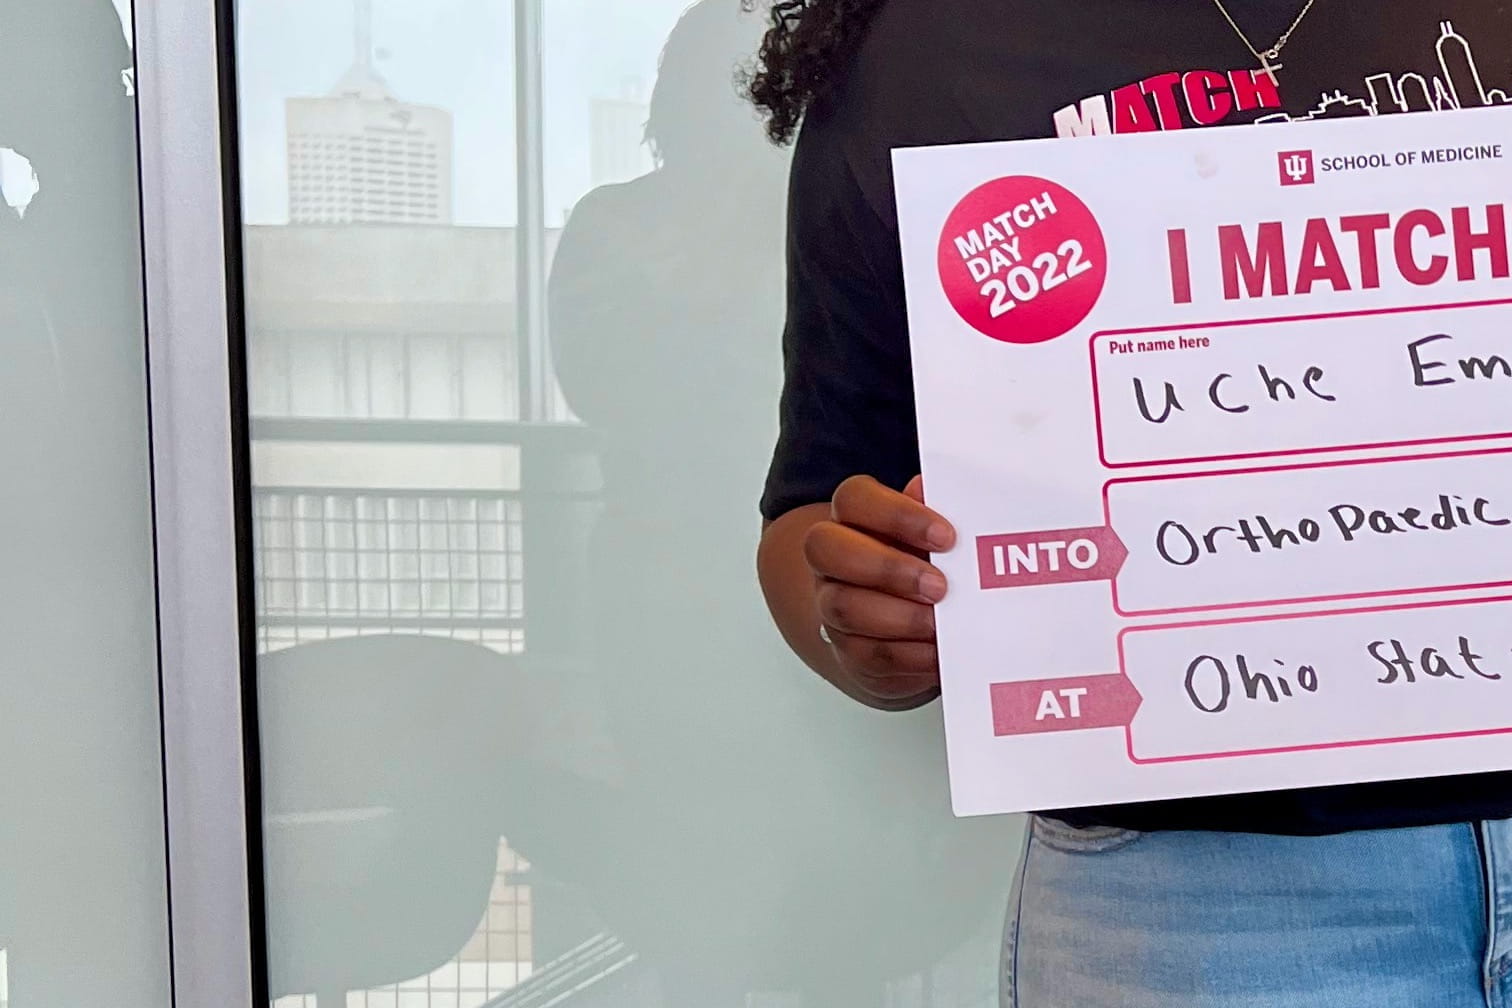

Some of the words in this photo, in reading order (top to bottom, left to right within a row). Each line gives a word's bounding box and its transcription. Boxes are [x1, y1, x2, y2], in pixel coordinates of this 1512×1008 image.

[1053, 69, 1281, 138] MATCH
[1320, 153, 1391, 172] SCHOOL
[1395, 151, 1417, 166] OF
[1421, 144, 1504, 164] MEDICINE
[953, 191, 1058, 260] MATCH
[966, 236, 1023, 283] DAY
[980, 239, 1093, 319] 2022
[1168, 229, 1192, 304] I
[1109, 340, 1134, 354] Put
[1137, 339, 1176, 353] name
[1178, 335, 1210, 349] here
[992, 538, 1099, 576] INTO
[1035, 687, 1088, 721] AT
[1184, 654, 1318, 713] Ohio
